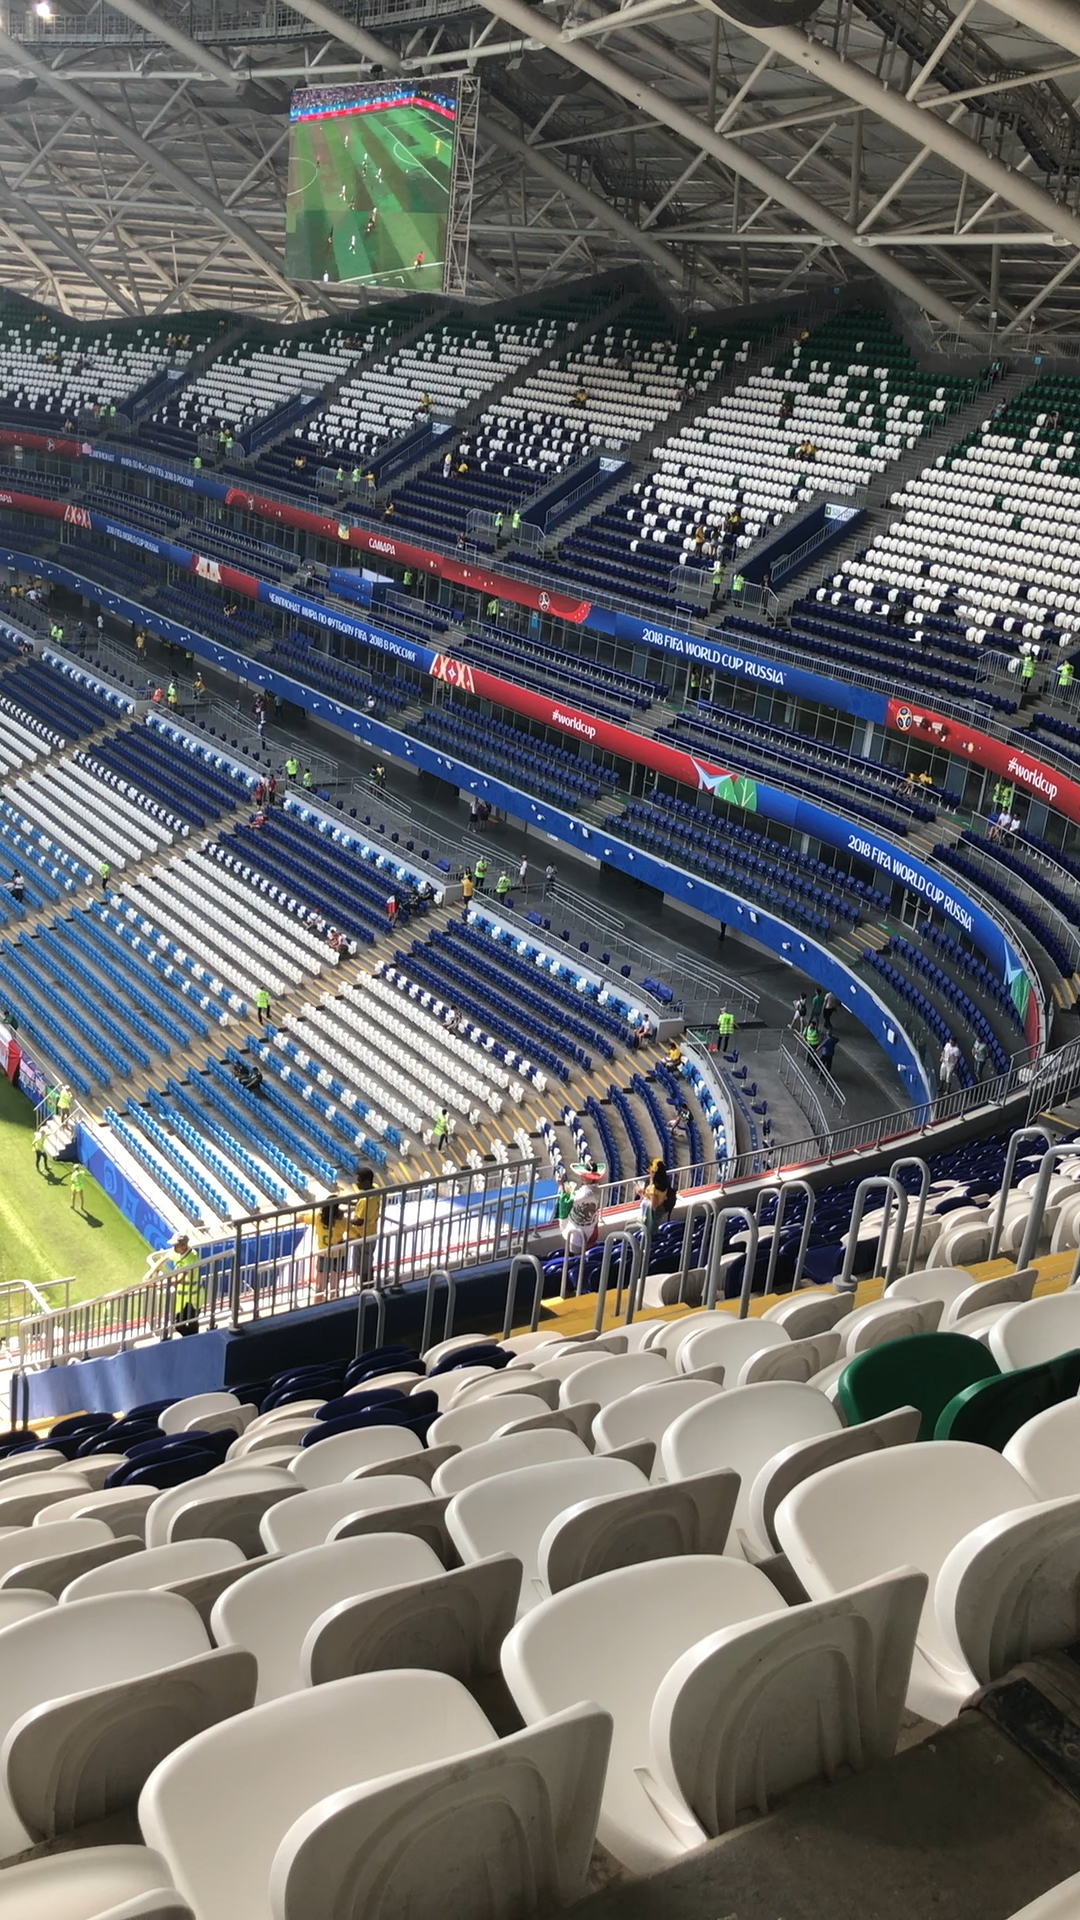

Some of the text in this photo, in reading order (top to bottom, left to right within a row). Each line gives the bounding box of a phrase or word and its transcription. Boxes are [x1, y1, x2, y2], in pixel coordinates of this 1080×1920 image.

[301, 604, 318, 621] МИРА
[318, 612, 327, 625] ПО
[327, 616, 354, 636] ФУТБОЛУ
[354, 627, 368, 642] FIFA
[368, 633, 384, 649] 2018
[642, 627, 664, 646] 2018
[664, 634, 684, 653] FIFA
[685, 641, 721, 664] WORLD
[721, 653, 744, 671] CUP
[552, 708, 596, 740] #worldcup
[1007, 756, 1058, 801] #worldcup
[847, 834, 871, 858] 2018
[871, 846, 891, 871] FIFA
[892, 858, 926, 892] WORLD
[925, 881, 944, 904] CUP
